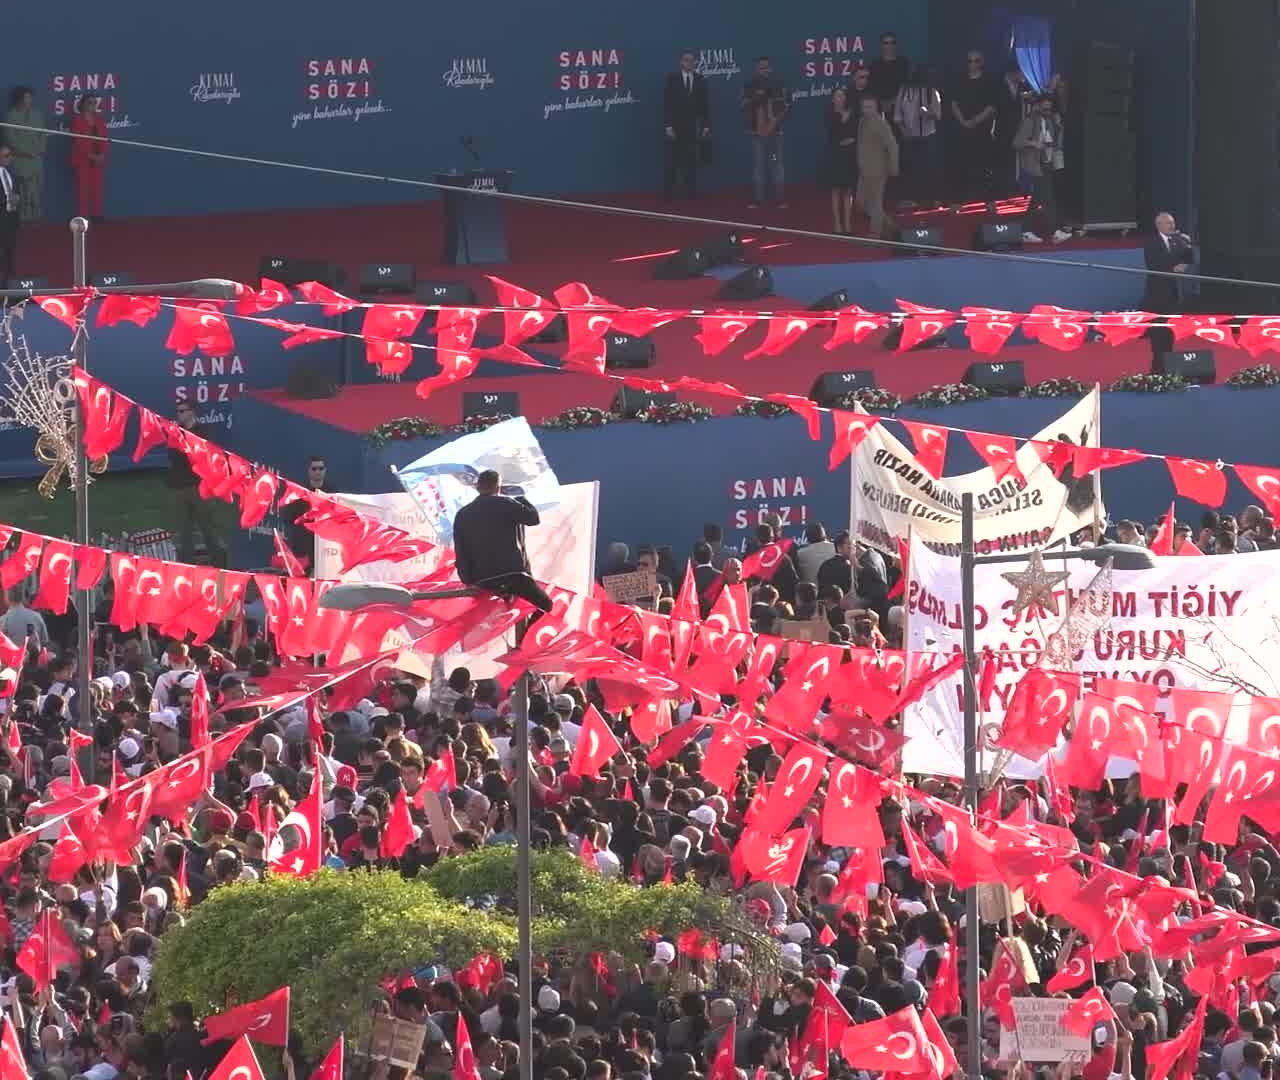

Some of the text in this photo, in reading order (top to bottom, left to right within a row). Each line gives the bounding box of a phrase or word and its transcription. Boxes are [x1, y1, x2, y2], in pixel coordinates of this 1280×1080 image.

[805, 36, 864, 54] SANA
[308, 58, 370, 76] SANA
[560, 49, 619, 67] SANA
[54, 73, 116, 92] SANA
[309, 79, 369, 100] SÖZ!
[560, 70, 619, 90] SÖZ!
[174, 356, 244, 377] SANA
[734, 476, 806, 500] SANA
